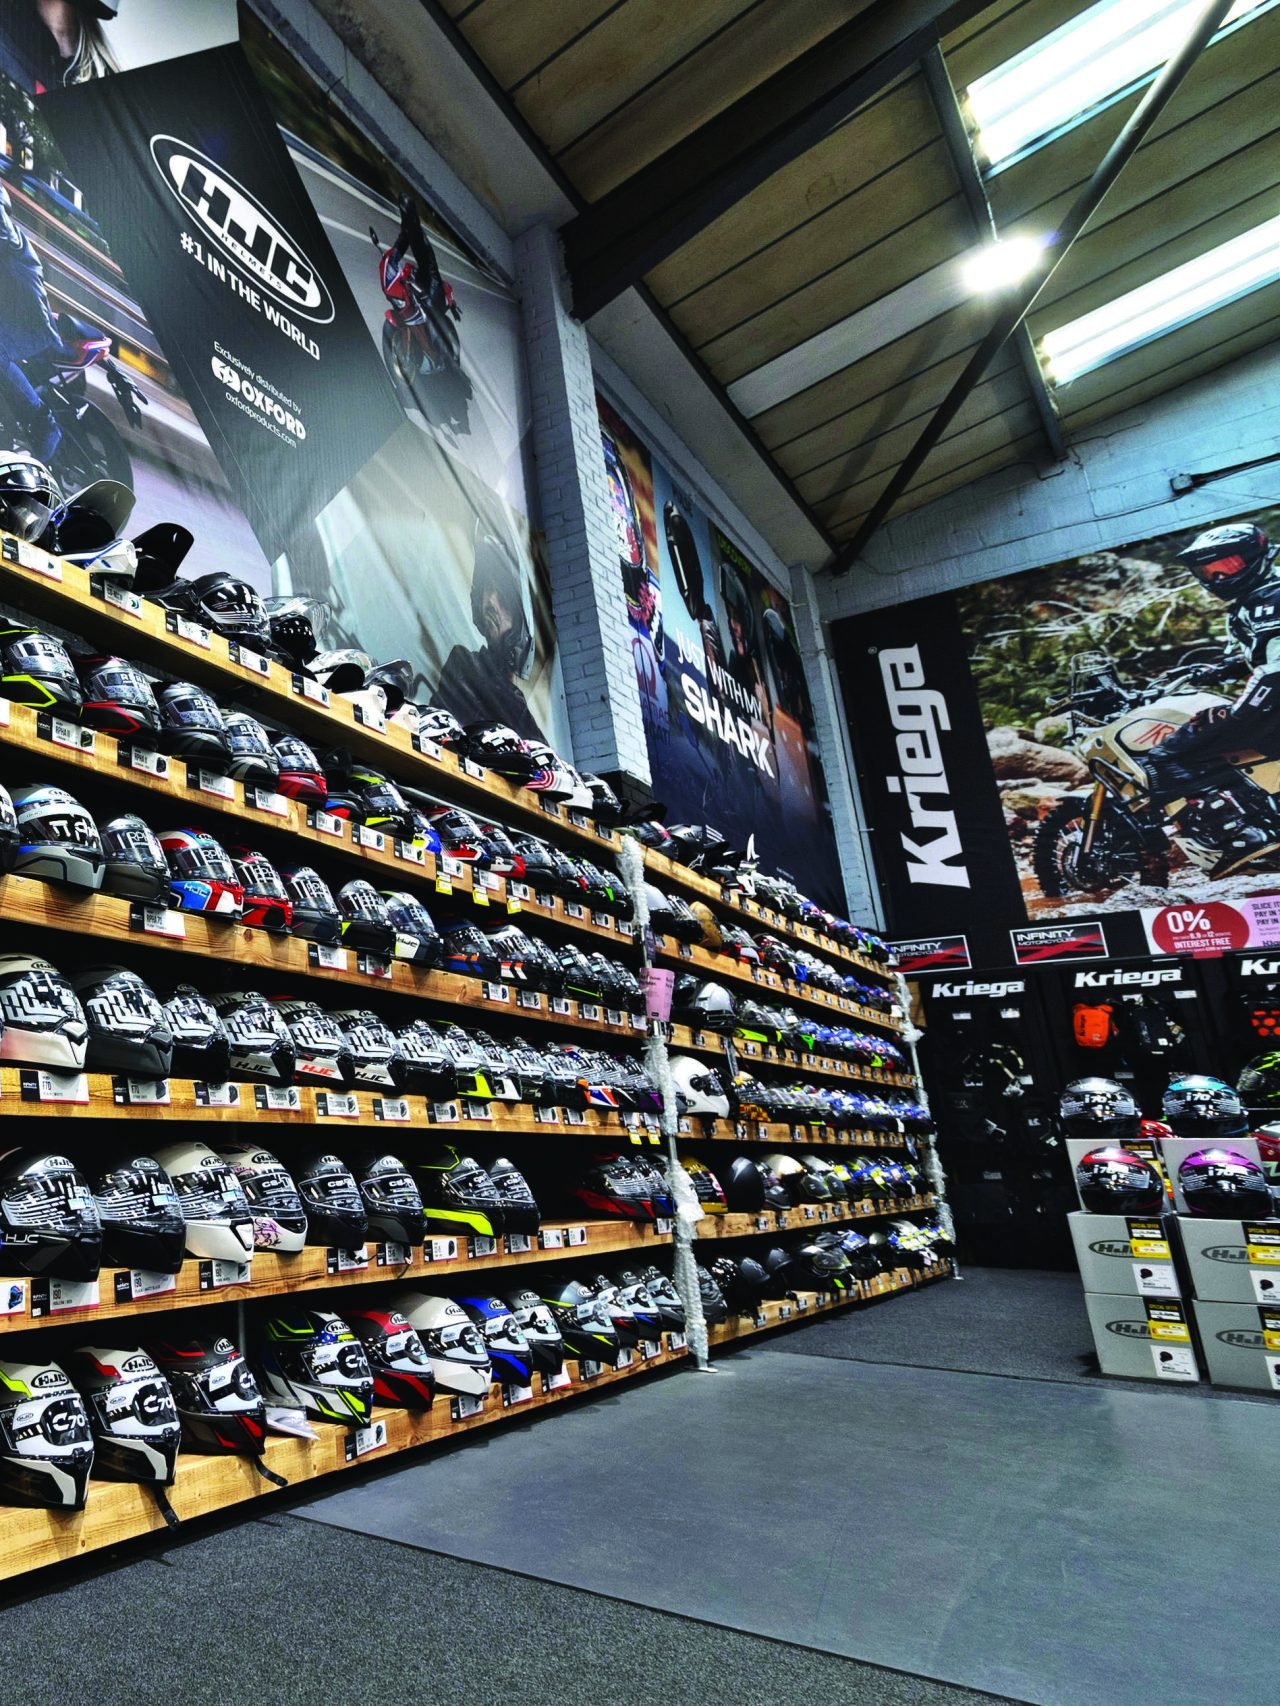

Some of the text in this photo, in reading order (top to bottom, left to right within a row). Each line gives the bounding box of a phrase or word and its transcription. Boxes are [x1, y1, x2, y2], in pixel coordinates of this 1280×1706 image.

[181, 163, 313, 302] HJC
[221, 232, 283, 289] HELMETS
[180, 232, 321, 360] #1 IN THE WORLD
[214, 341, 256, 379] Exclusively
[256, 364, 293, 406] distributed
[225, 391, 298, 449] oxfordproducts.com
[241, 380, 307, 441] OXFORD
[675, 627, 763, 720] JUST WITH MY
[680, 672, 776, 779] SHARK
[878, 643, 972, 889] Kriega
[1166, 909, 1211, 933] 0%
[1016, 929, 1075, 942] INFINITY
[1174, 937, 1231, 949] INTEREST FREE
[1075, 966, 1182, 988] Kriega
[932, 980, 1025, 998] Kriega
[234, 1060, 272, 1075] HJC
[301, 1063, 336, 1077] HJC
[354, 1070, 388, 1083] HJC
[5, 1234, 39, 1244] HJC
[127, 1356, 153, 1370] HJC
[37, 1373, 68, 1387] HJC
[143, 1393, 174, 1414] C70
[52, 1411, 85, 1432] C70
